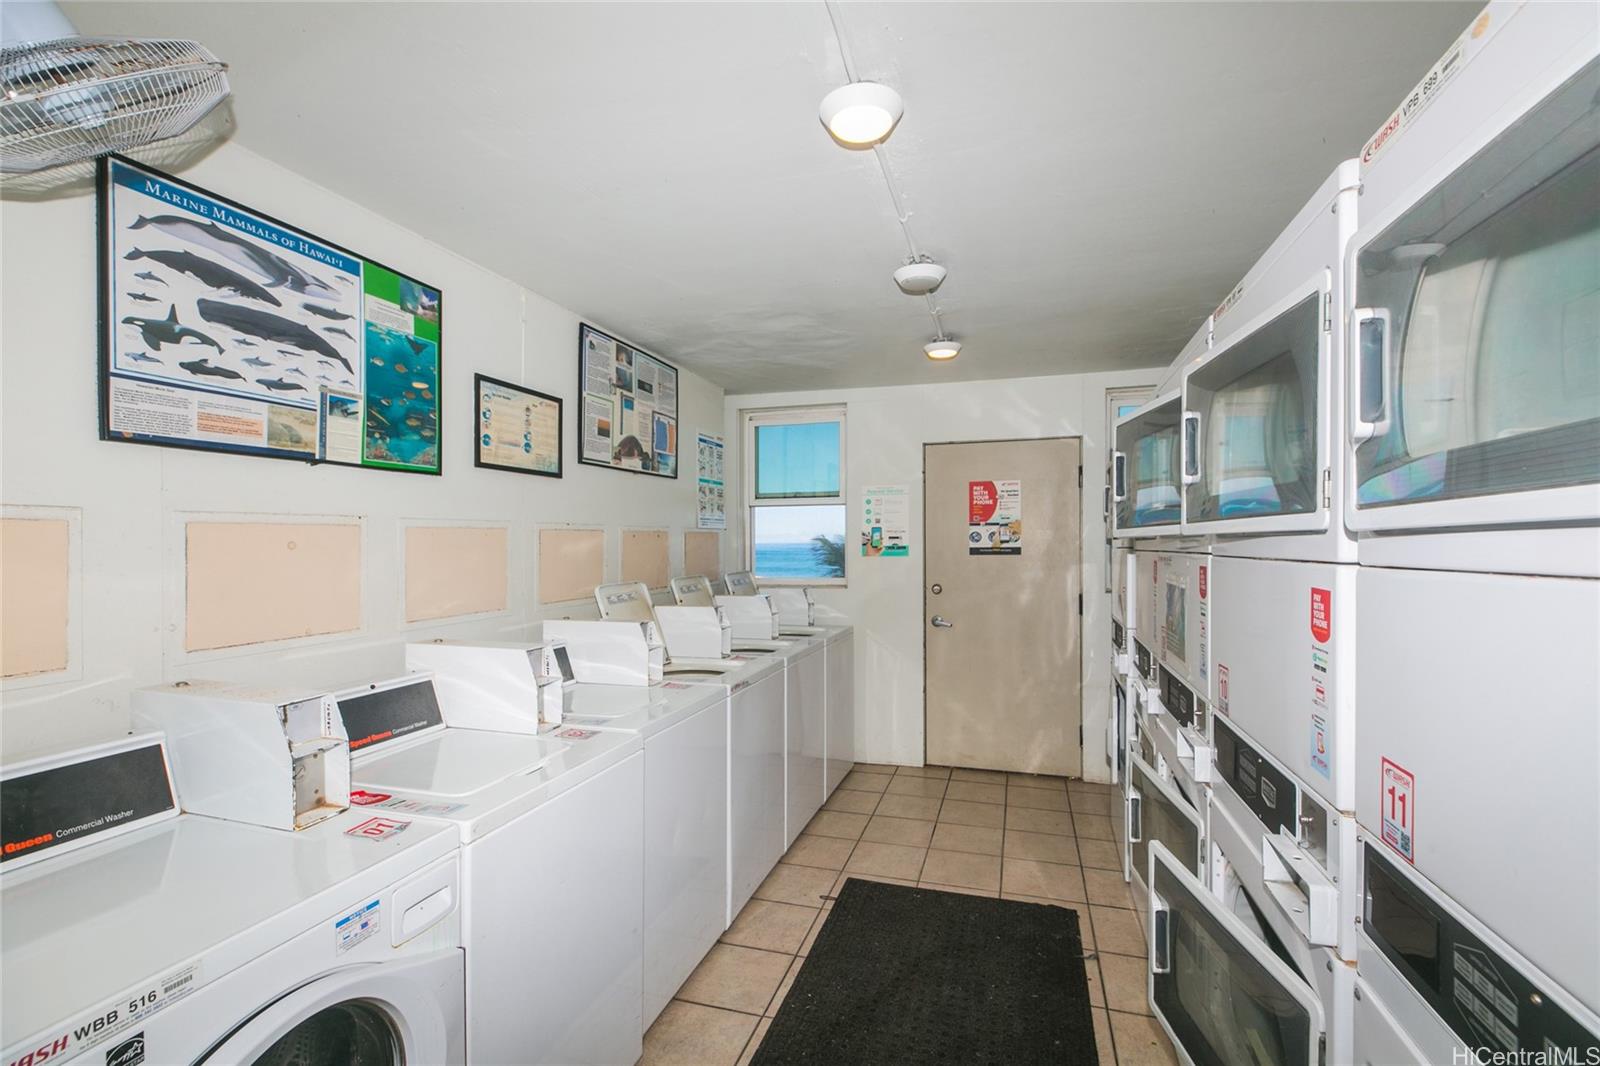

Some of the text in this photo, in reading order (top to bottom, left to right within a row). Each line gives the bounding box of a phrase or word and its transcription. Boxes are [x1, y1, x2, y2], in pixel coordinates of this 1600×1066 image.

[1375, 113, 1400, 150] WASH
[1402, 92, 1419, 117] VPB
[1313, 593, 1321, 601] PAY
[1313, 601, 1324, 609] WITH
[1313, 610, 1325, 619] YOUR
[1313, 618, 1328, 629] PHONE
[1388, 785, 1406, 828] 11
[5, 832, 53, 855] Queen
[55, 818, 105, 839] Commercial
[105, 808, 135, 824] Washer
[9, 1034, 70, 1066] ASH
[73, 1010, 119, 1042] WBB
[128, 989, 158, 1014] 516
